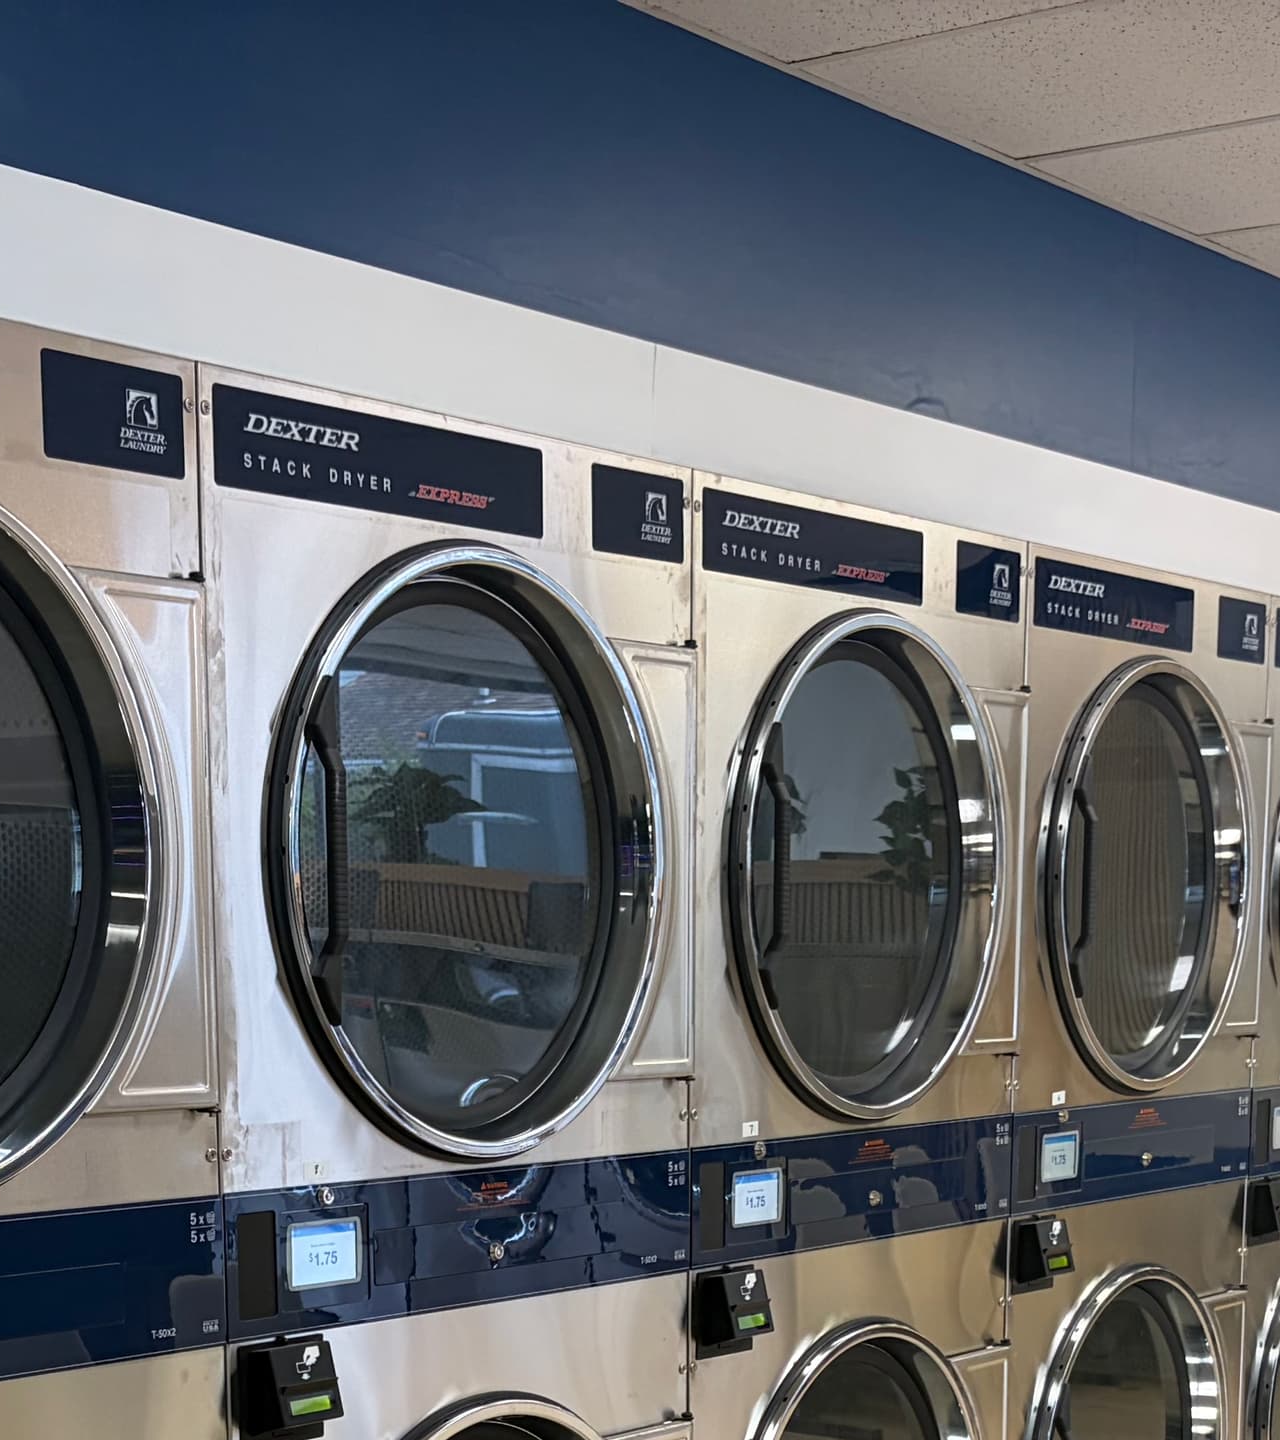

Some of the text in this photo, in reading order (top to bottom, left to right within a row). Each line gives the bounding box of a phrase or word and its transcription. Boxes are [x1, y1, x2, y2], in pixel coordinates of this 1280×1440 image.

[120, 426, 165, 445] DEXTER
[243, 412, 360, 451] DEXTER
[243, 453, 392, 493] STACK DRYER
[416, 484, 489, 510] EXPRESS
[722, 509, 800, 540] DEXTER
[721, 542, 821, 573] STACK DRYER
[1048, 575, 1105, 598] DEXTER
[1047, 602, 1119, 625] STACK DRYER
[190, 1212, 197, 1226] 5
[190, 1230, 198, 1243] 5
[309, 1250, 338, 1266] $1.75
[151, 1328, 177, 1340] T-50X2
